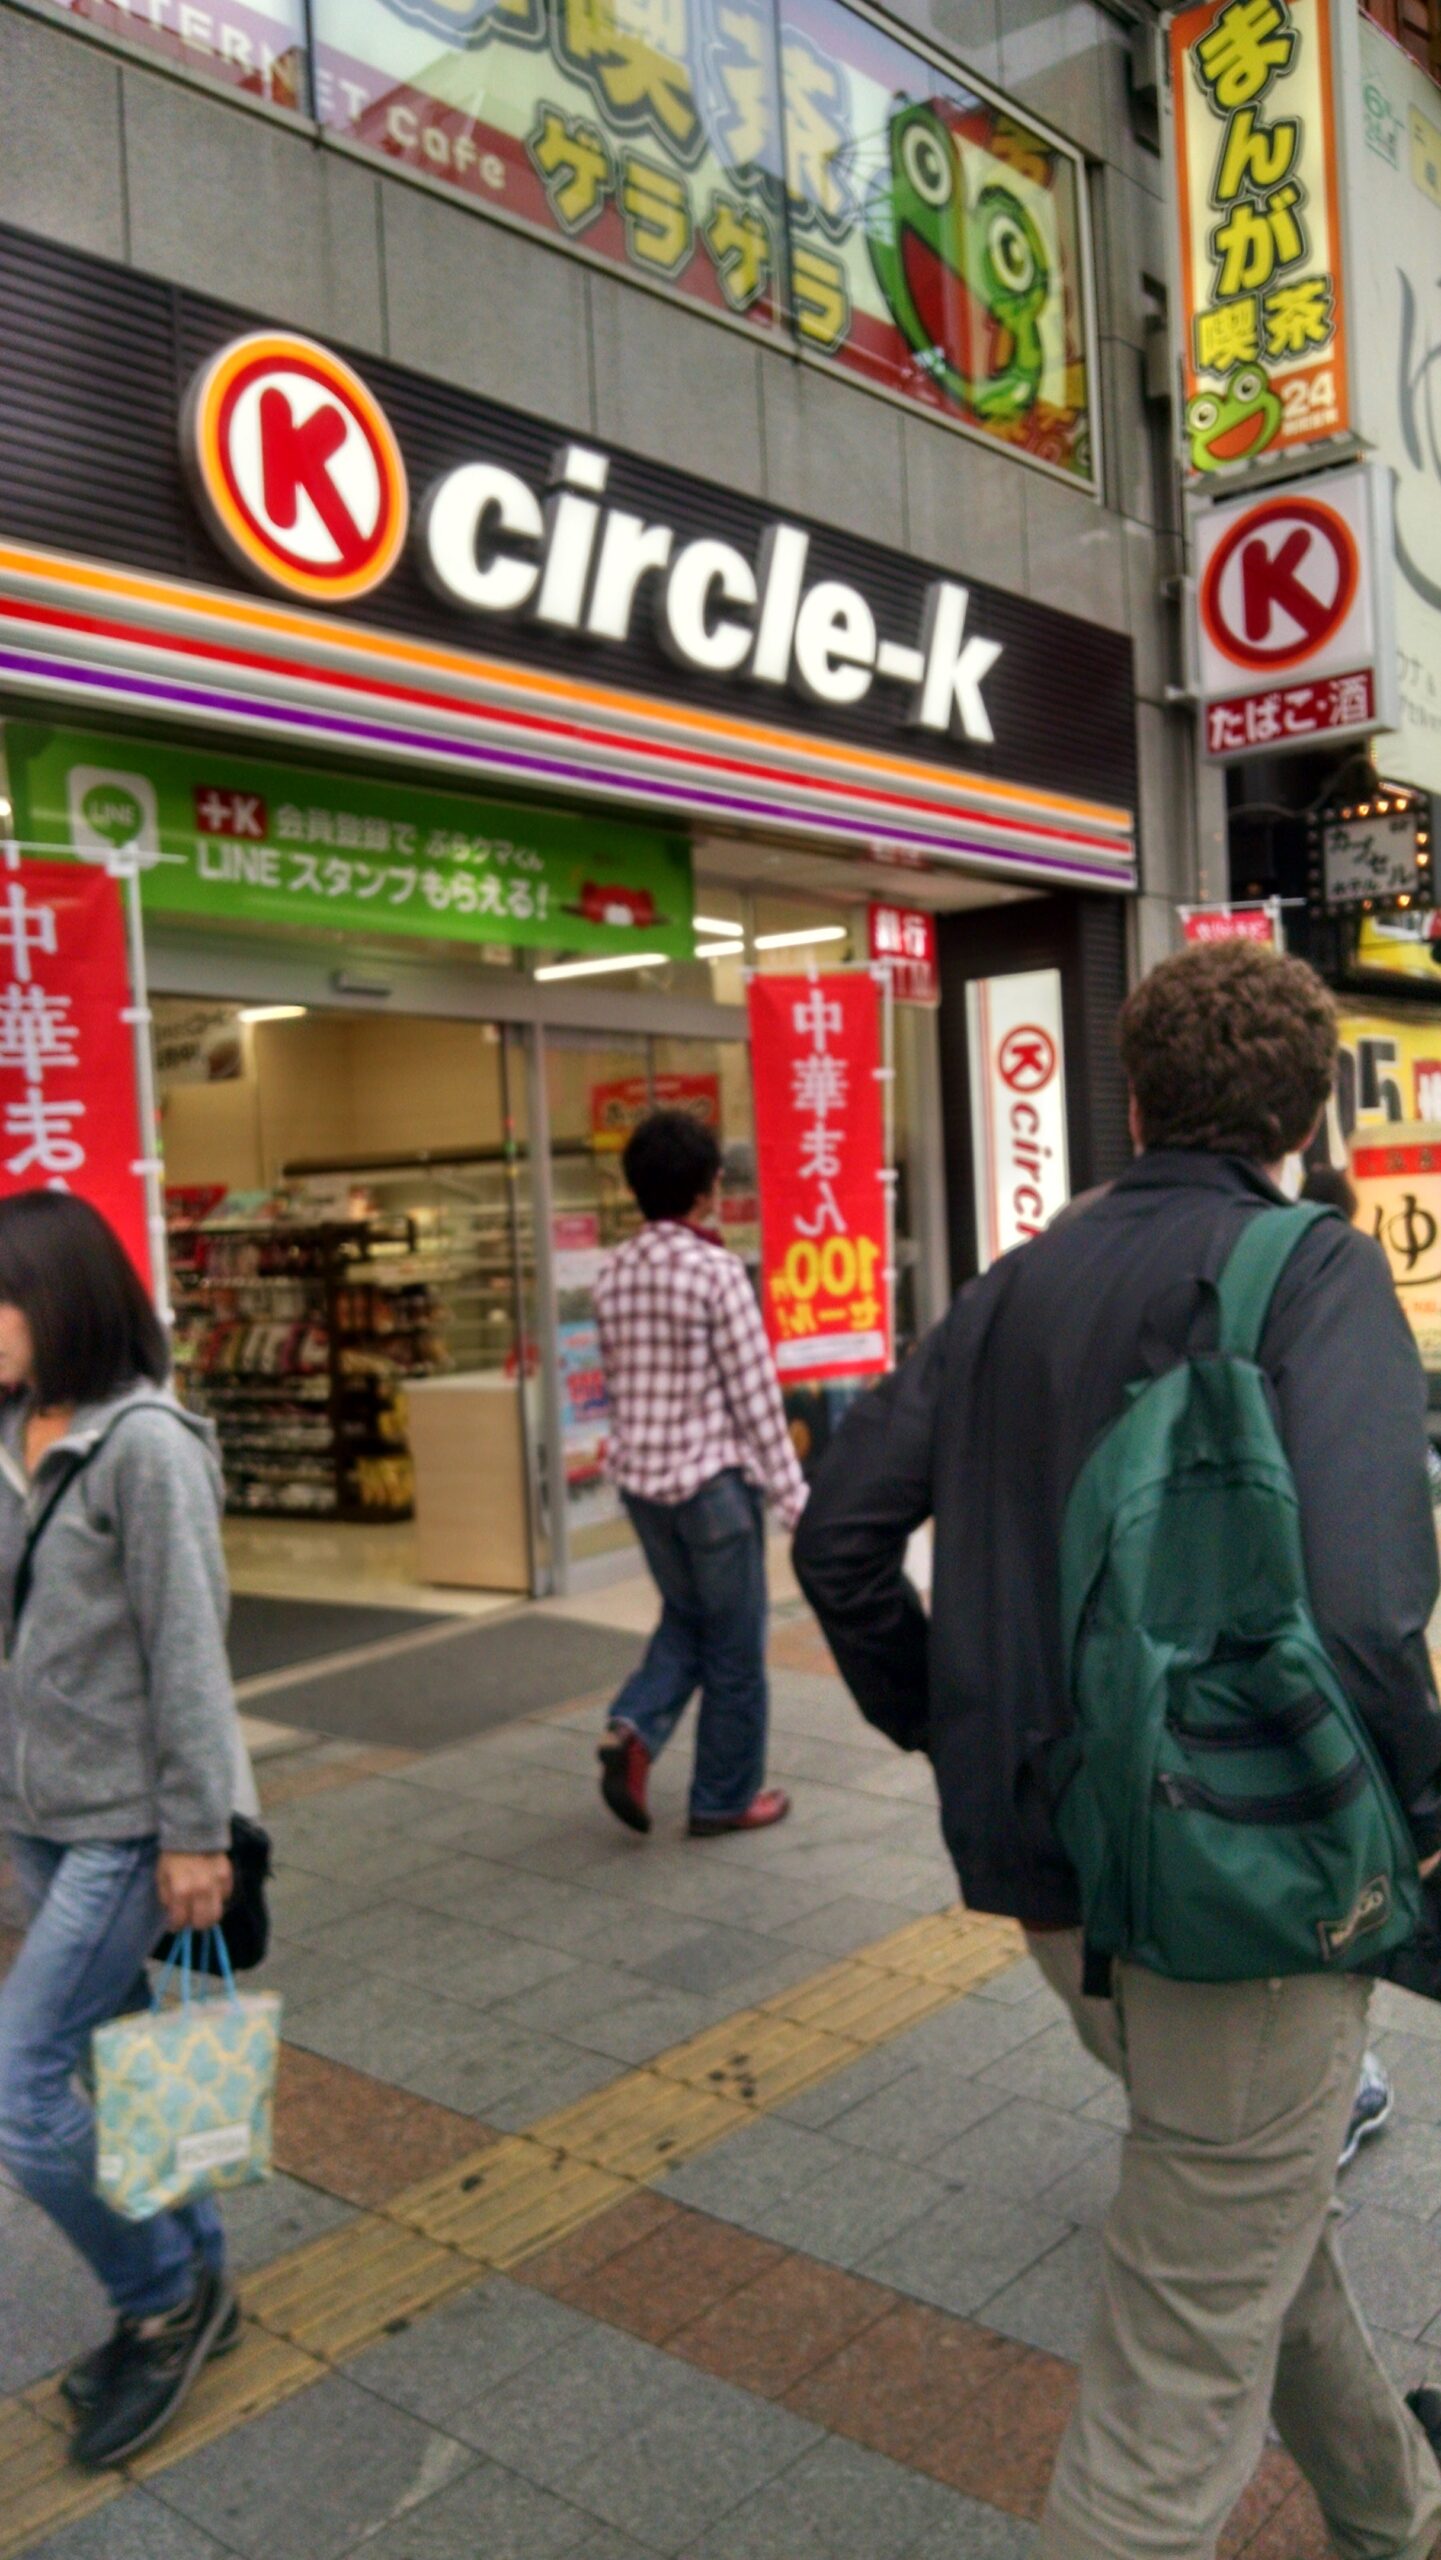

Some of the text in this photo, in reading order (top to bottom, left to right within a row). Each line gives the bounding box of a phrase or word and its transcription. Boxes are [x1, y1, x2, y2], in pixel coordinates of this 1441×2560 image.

[95, 0, 507, 190] TERNET Cafe
[1197, 0, 1303, 298] まんが
[1199, 277, 1334, 371] 喫茶
[1281, 370, 1336, 419] 24
[259, 387, 376, 565] K
[427, 446, 1003, 743] circle-k
[1241, 527, 1334, 643] K
[198, 840, 283, 888] LINE
